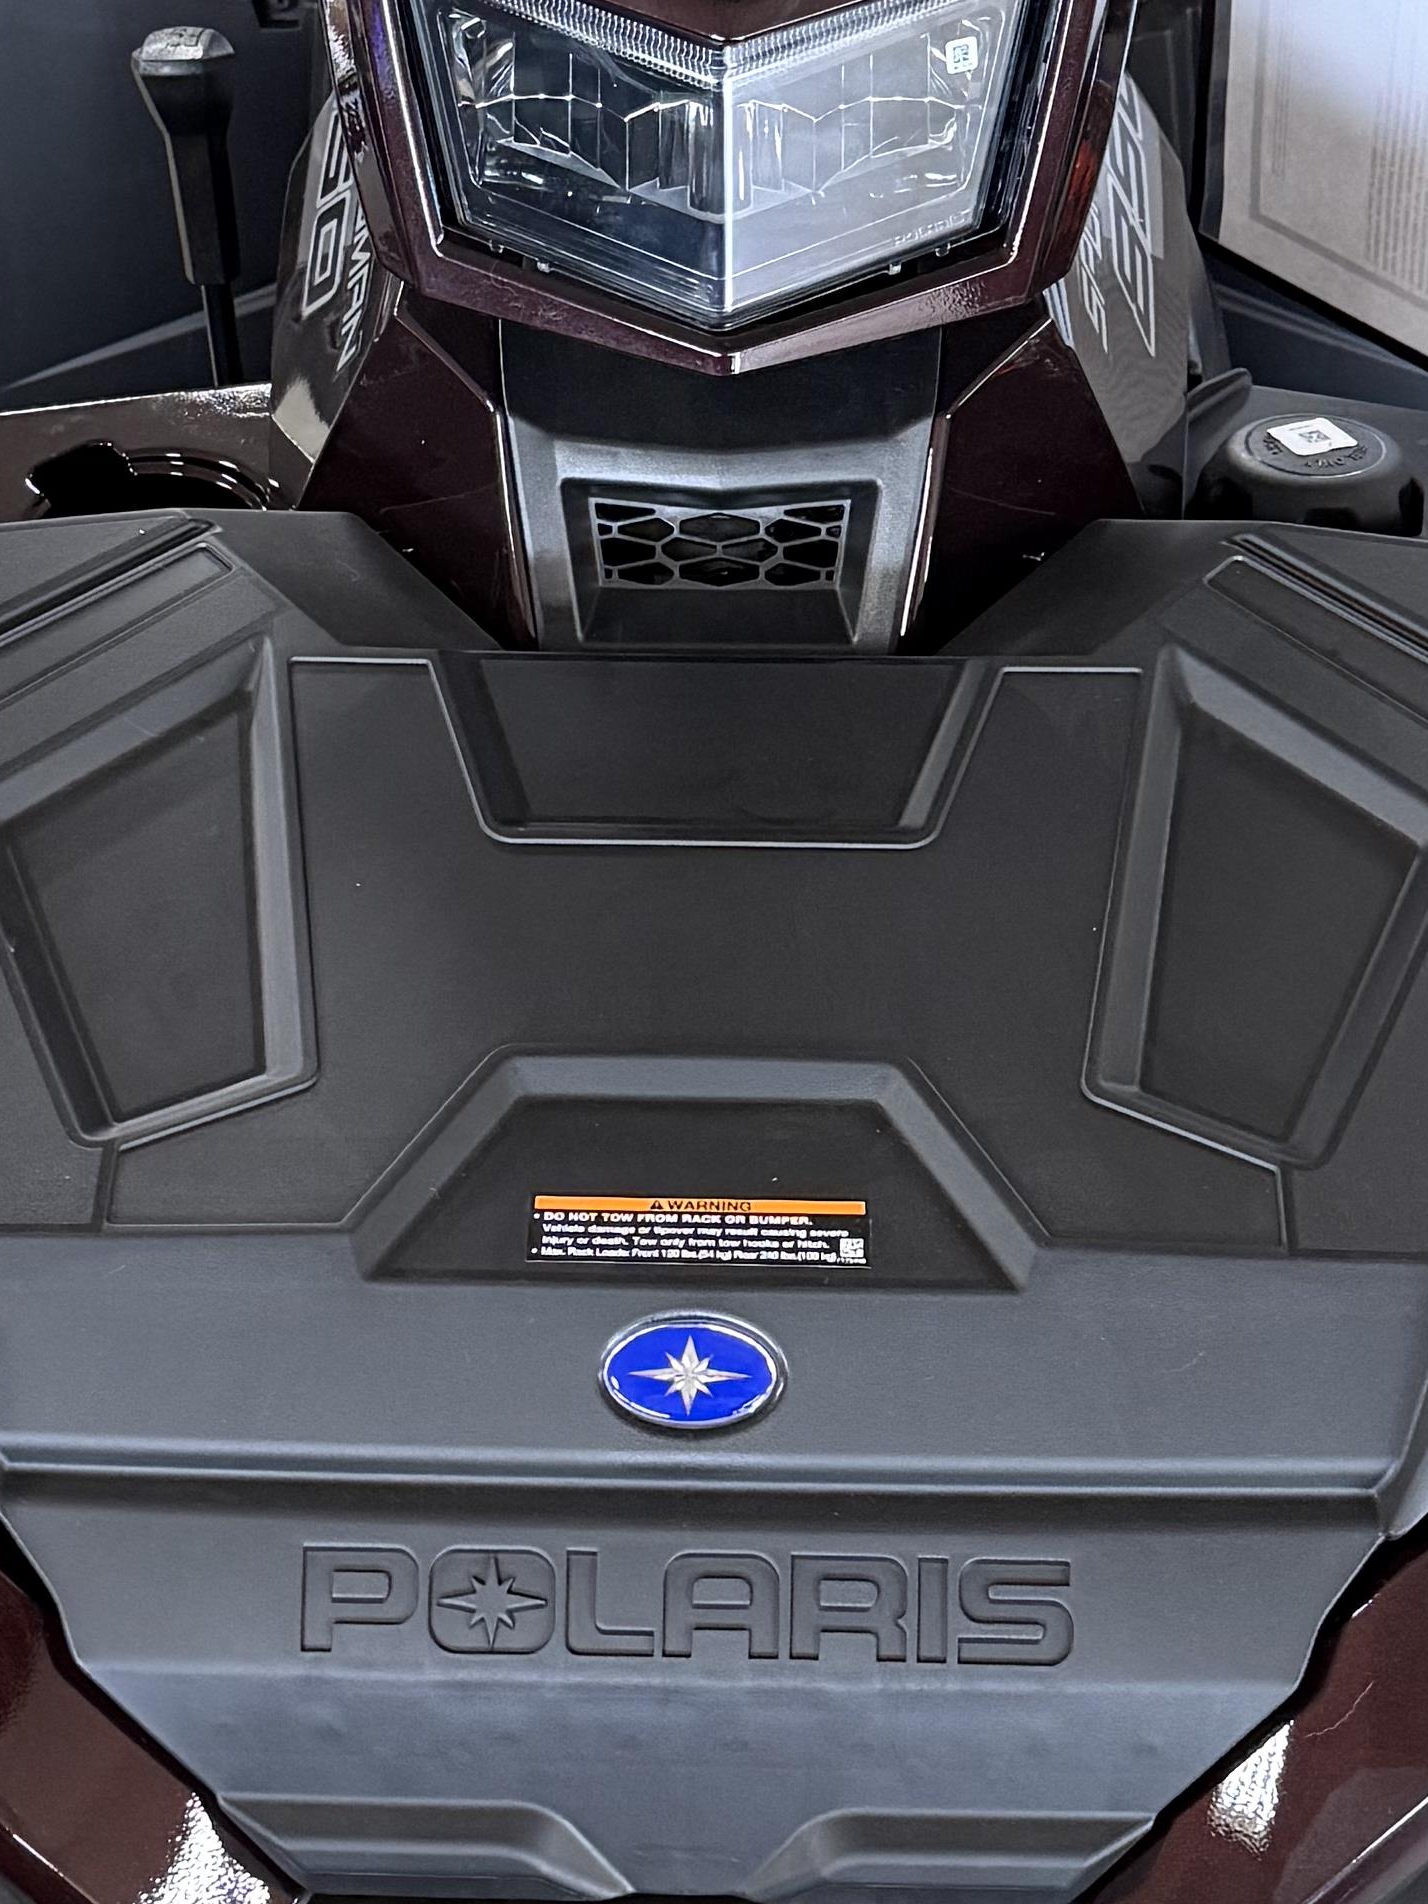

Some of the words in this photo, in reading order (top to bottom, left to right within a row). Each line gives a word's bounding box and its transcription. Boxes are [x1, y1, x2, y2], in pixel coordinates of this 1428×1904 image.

[667, 1200, 751, 1212] WARNING
[543, 1212, 565, 1221] DO
[568, 1212, 598, 1222] NOT
[601, 1213, 634, 1222] TOW
[637, 1213, 678, 1223] FROM
[681, 1214, 721, 1224] RACK
[724, 1215, 746, 1224] OR
[749, 1215, 813, 1225] BUMPER.
[542, 1223, 585, 1233] Vehicle
[587, 1224, 636, 1235] damage
[638, 1226, 651, 1234] or
[697, 1228, 722, 1237] may
[724, 1227, 758, 1236] result
[760, 1228, 807, 1238] causing
[809, 1229, 849, 1237] severe
[576, 1237, 590, 1245] or
[631, 1237, 659, 1246] Tow
[660, 1238, 686, 1248] only
[688, 1238, 716, 1247] from
[718, 1239, 741, 1247] tow
[301, 1543, 1075, 1667] POLARIS
